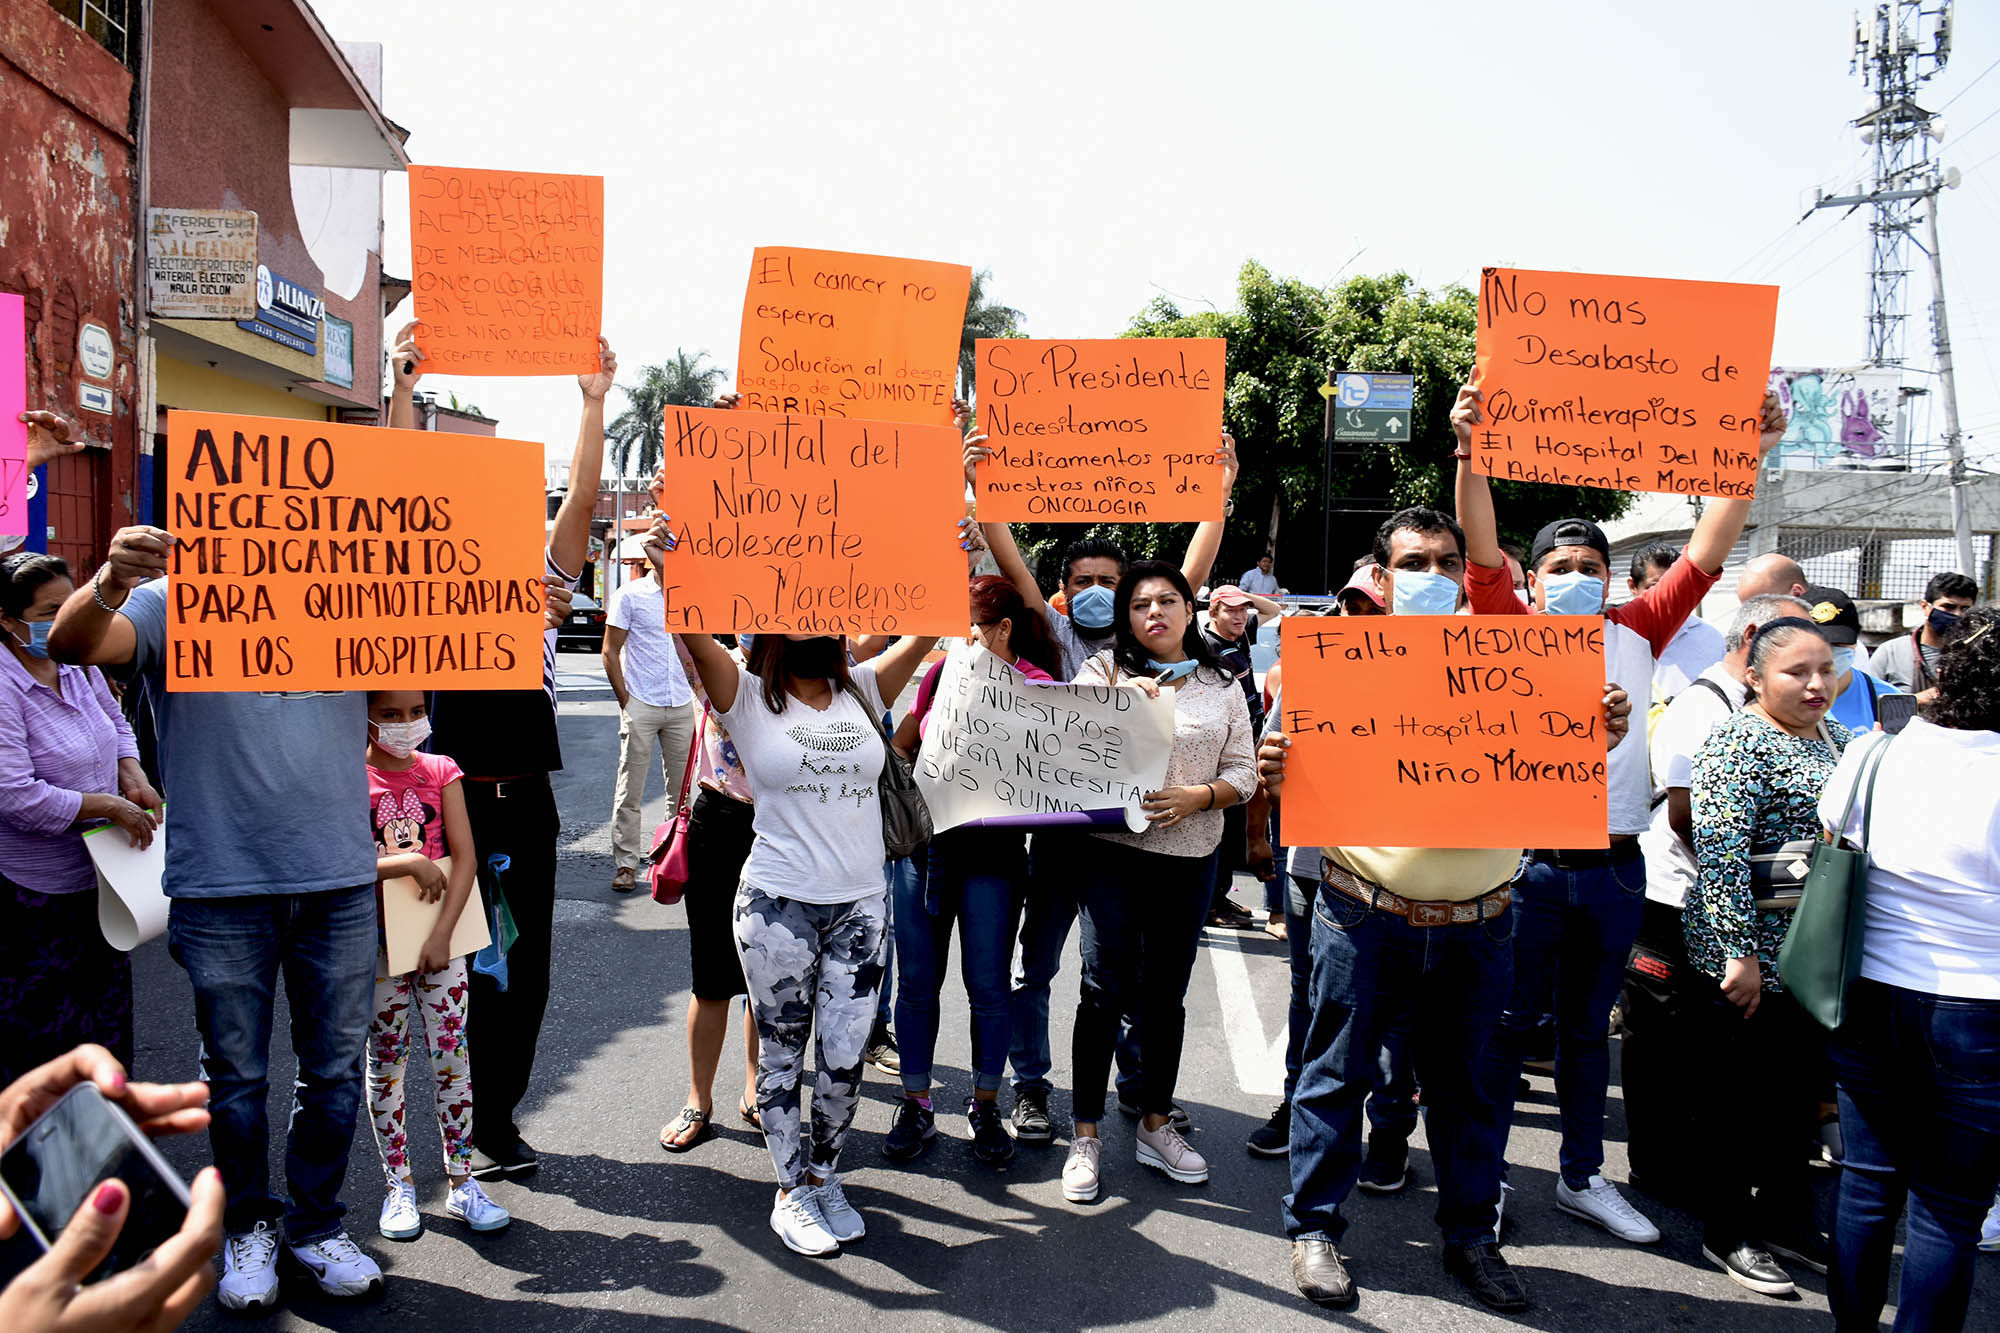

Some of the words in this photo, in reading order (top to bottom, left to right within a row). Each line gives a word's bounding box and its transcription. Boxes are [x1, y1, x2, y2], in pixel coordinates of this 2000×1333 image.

[148, 257, 254, 273] ELECTROFERRETERA
[416, 245, 448, 265] DE
[170, 283, 198, 294] MALLA
[757, 256, 795, 287] El
[814, 271, 887, 294] cancer
[903, 282, 937, 302] no
[277, 281, 326, 322] ALIANZA
[416, 296, 449, 313] EN
[462, 300, 488, 316] EL
[1569, 298, 1647, 325] mas
[417, 322, 457, 339] DEL
[466, 323, 511, 341] NIÑO
[864, 358, 883, 377] al
[988, 345, 1042, 397] Sr.
[1041, 344, 1210, 391] Presidente
[1513, 333, 1678, 375] Desabasto
[1702, 355, 1739, 382] de
[741, 369, 800, 393] basto
[809, 379, 830, 395] de
[987, 404, 1148, 437] Necesitamos
[1486, 388, 1697, 432] Quimiterapias
[1719, 413, 1756, 435] en
[185, 429, 335, 490] AMLO
[675, 410, 827, 483] Hospital
[850, 428, 900, 469] del
[987, 445, 1152, 469] Medicamentos
[1162, 452, 1216, 477] para
[1480, 430, 1513, 451] El
[1536, 434, 1643, 464] Hospital
[1659, 445, 1698, 465] Del
[1713, 446, 1759, 471] Niño
[988, 475, 1083, 493] nuestros
[1093, 476, 1156, 495] niños
[1176, 476, 1204, 494] de
[1507, 460, 1641, 489] Adolecente
[176, 492, 452, 533] NECESITAMOS
[713, 466, 782, 520] Niño
[790, 492, 808, 528] y
[816, 479, 840, 517] el
[1028, 495, 1148, 515] ONCOLOGIA
[173, 536, 481, 577] MEDICAMENTOS
[675, 521, 863, 559] Adolescente
[176, 582, 277, 625] PARA
[304, 578, 541, 622] QUIMIOTERAPIAS
[765, 561, 927, 615] Morelense
[666, 585, 704, 631] En
[732, 593, 898, 633] Desabasto
[174, 639, 214, 678] EN
[241, 635, 293, 678] LOS
[336, 632, 516, 679] HOSPITALES
[1297, 631, 1408, 661] Falta
[1443, 625, 1604, 658] MEDICAME
[988, 656, 1014, 687] LA
[1446, 665, 1543, 698] NTOS.
[981, 685, 1124, 748] NUESTROS
[1287, 709, 1337, 735] En
[1351, 718, 1376, 737] el
[1393, 710, 1519, 745] Hospital
[1539, 711, 1596, 743] Del
[1026, 728, 1062, 757] NO
[1077, 743, 1122, 770] SE
[923, 754, 980, 791] SUS
[1397, 759, 1481, 786] Niño
